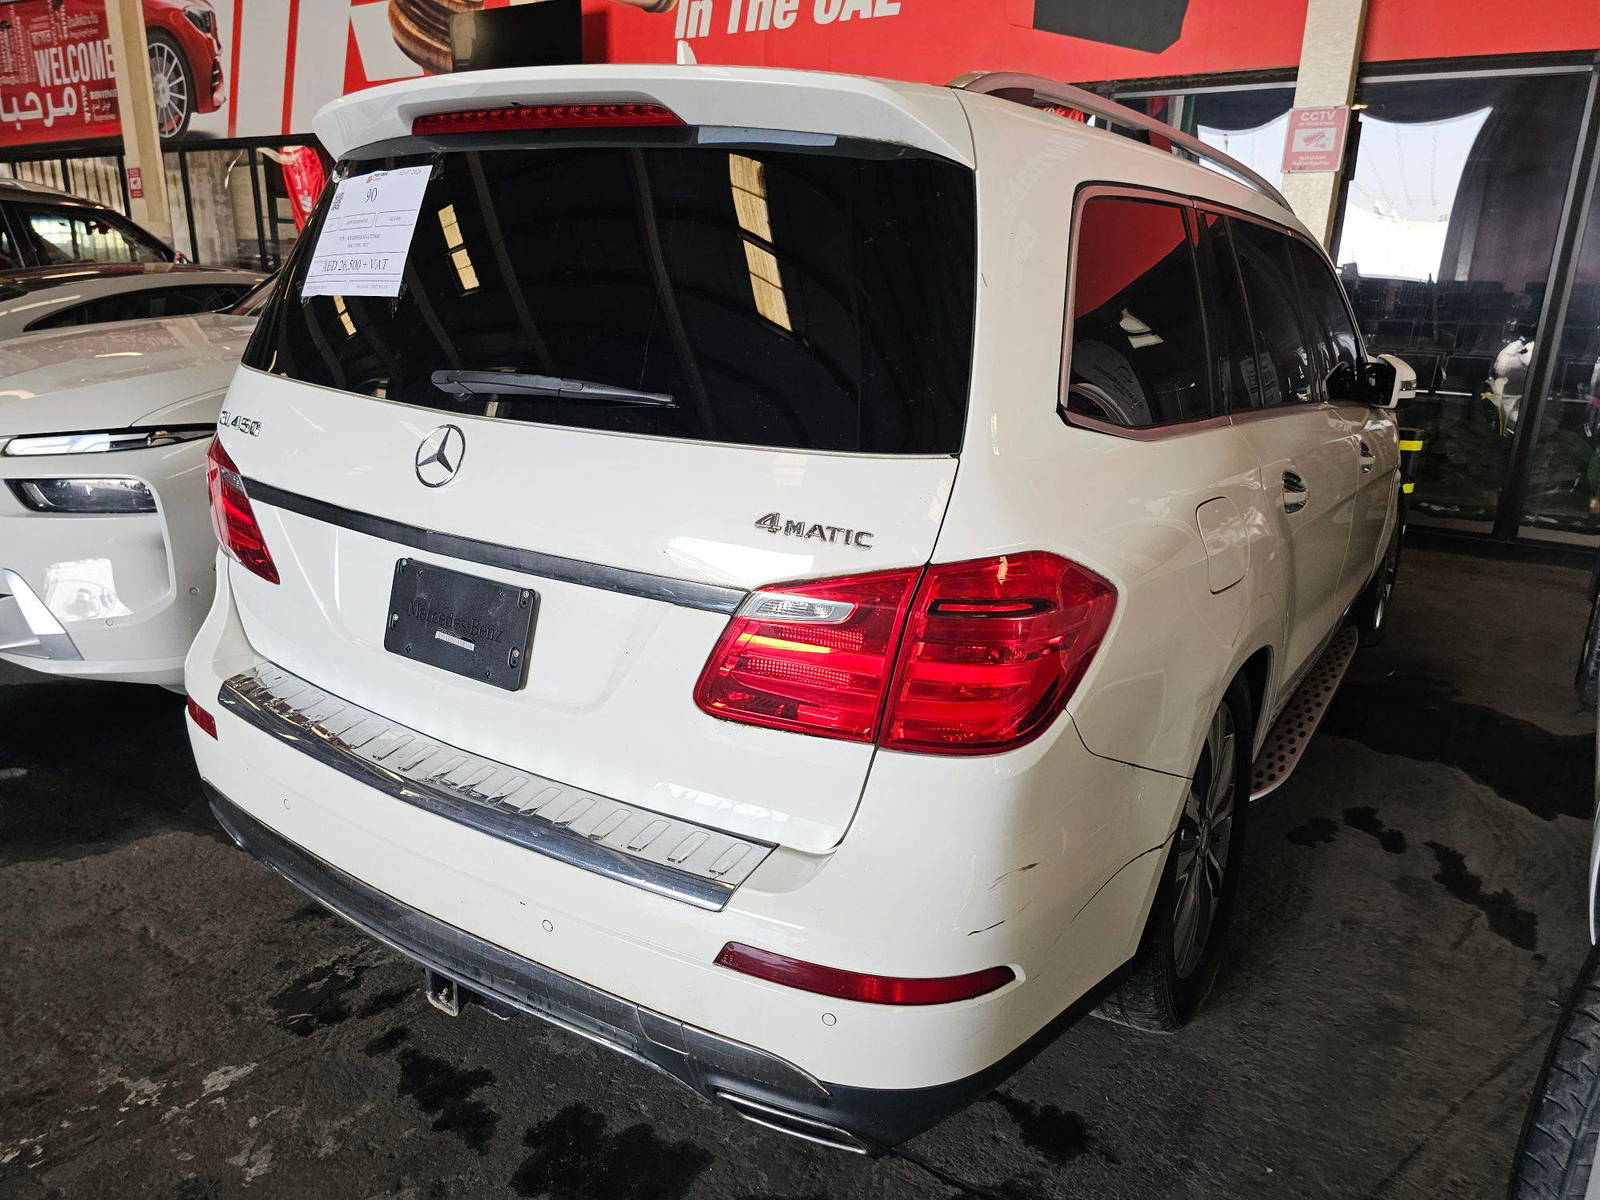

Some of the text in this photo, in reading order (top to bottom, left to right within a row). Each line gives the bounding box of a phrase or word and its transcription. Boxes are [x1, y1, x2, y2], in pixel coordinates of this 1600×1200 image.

[674, 0, 712, 39] In
[34, 39, 117, 88] WELCOME
[1300, 110, 1337, 122] CCTV
[365, 187, 378, 203] 90
[322, 260, 338, 273] AED
[370, 258, 389, 271] VAT
[754, 512, 875, 549] 4MATIC
[407, 600, 504, 644] Mercedes-Benz
